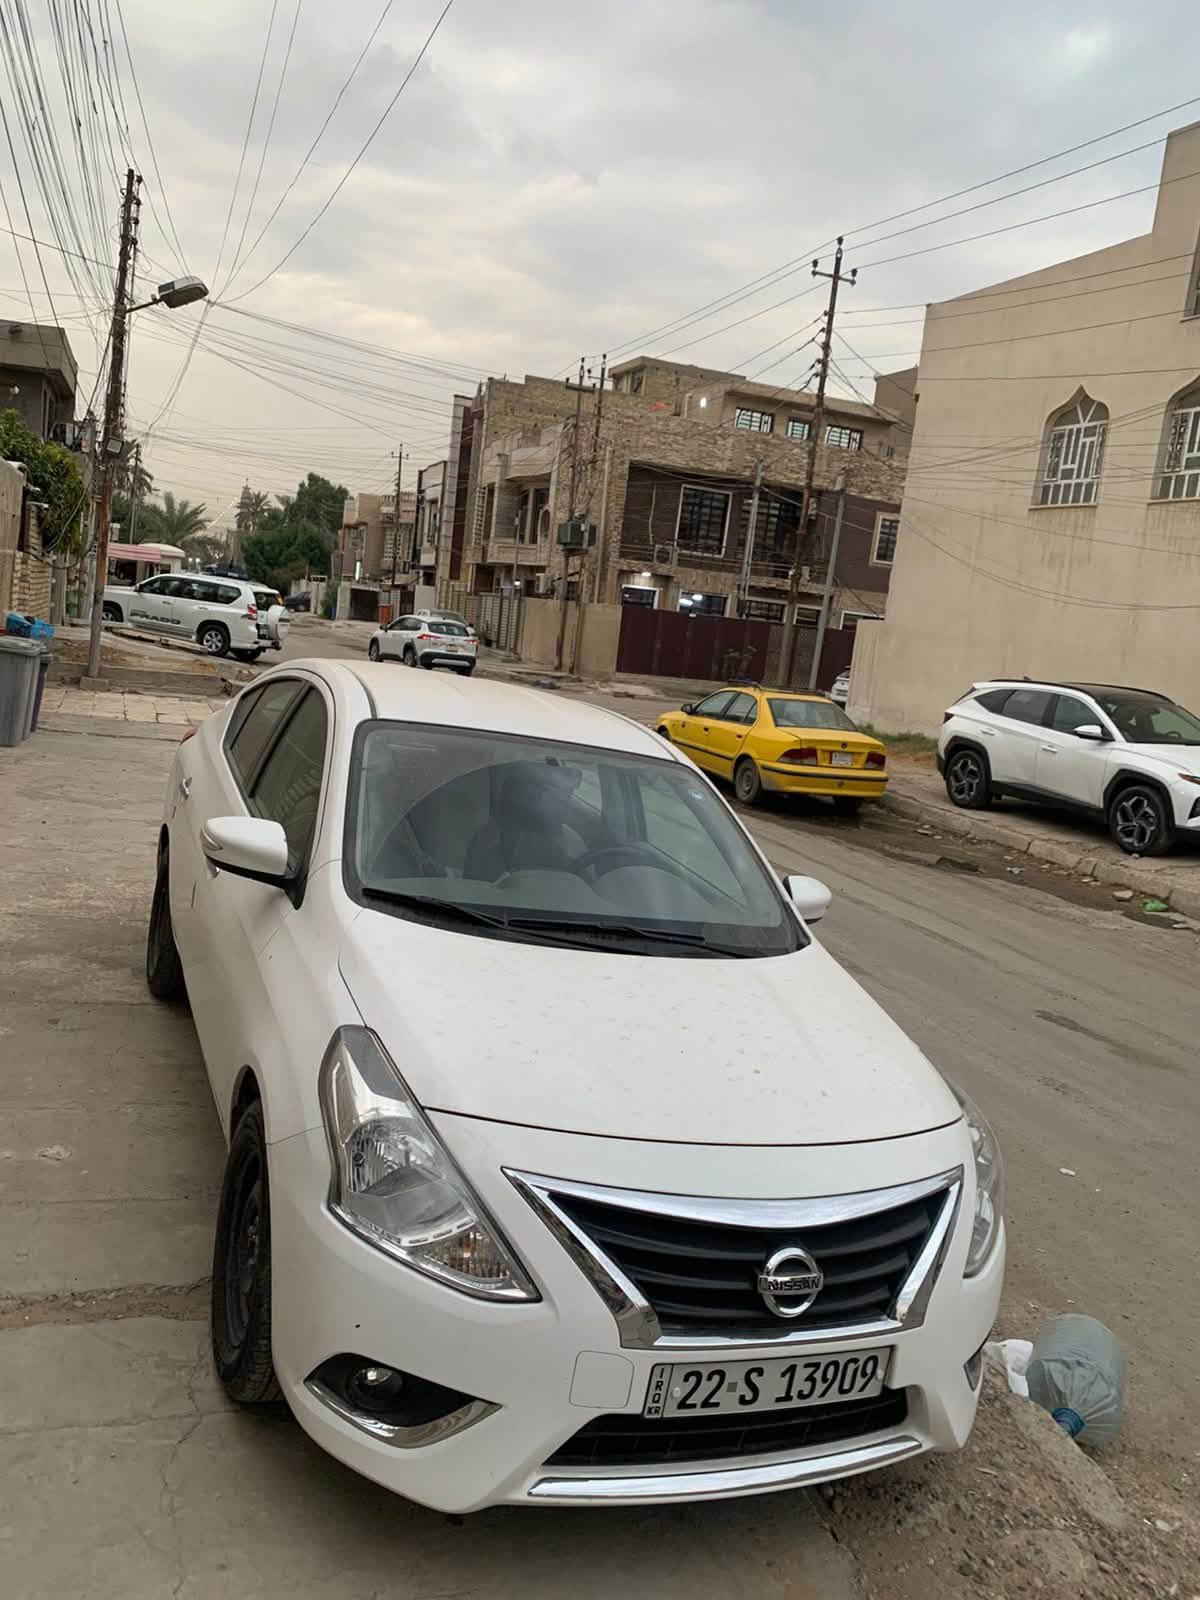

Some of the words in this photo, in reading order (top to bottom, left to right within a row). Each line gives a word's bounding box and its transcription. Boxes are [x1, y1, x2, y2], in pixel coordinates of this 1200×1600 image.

[768, 1277, 820, 1290] NISSAN
[677, 1370, 726, 1410] 22
[738, 1367, 764, 1406] S
[775, 1355, 879, 1403] 13909
